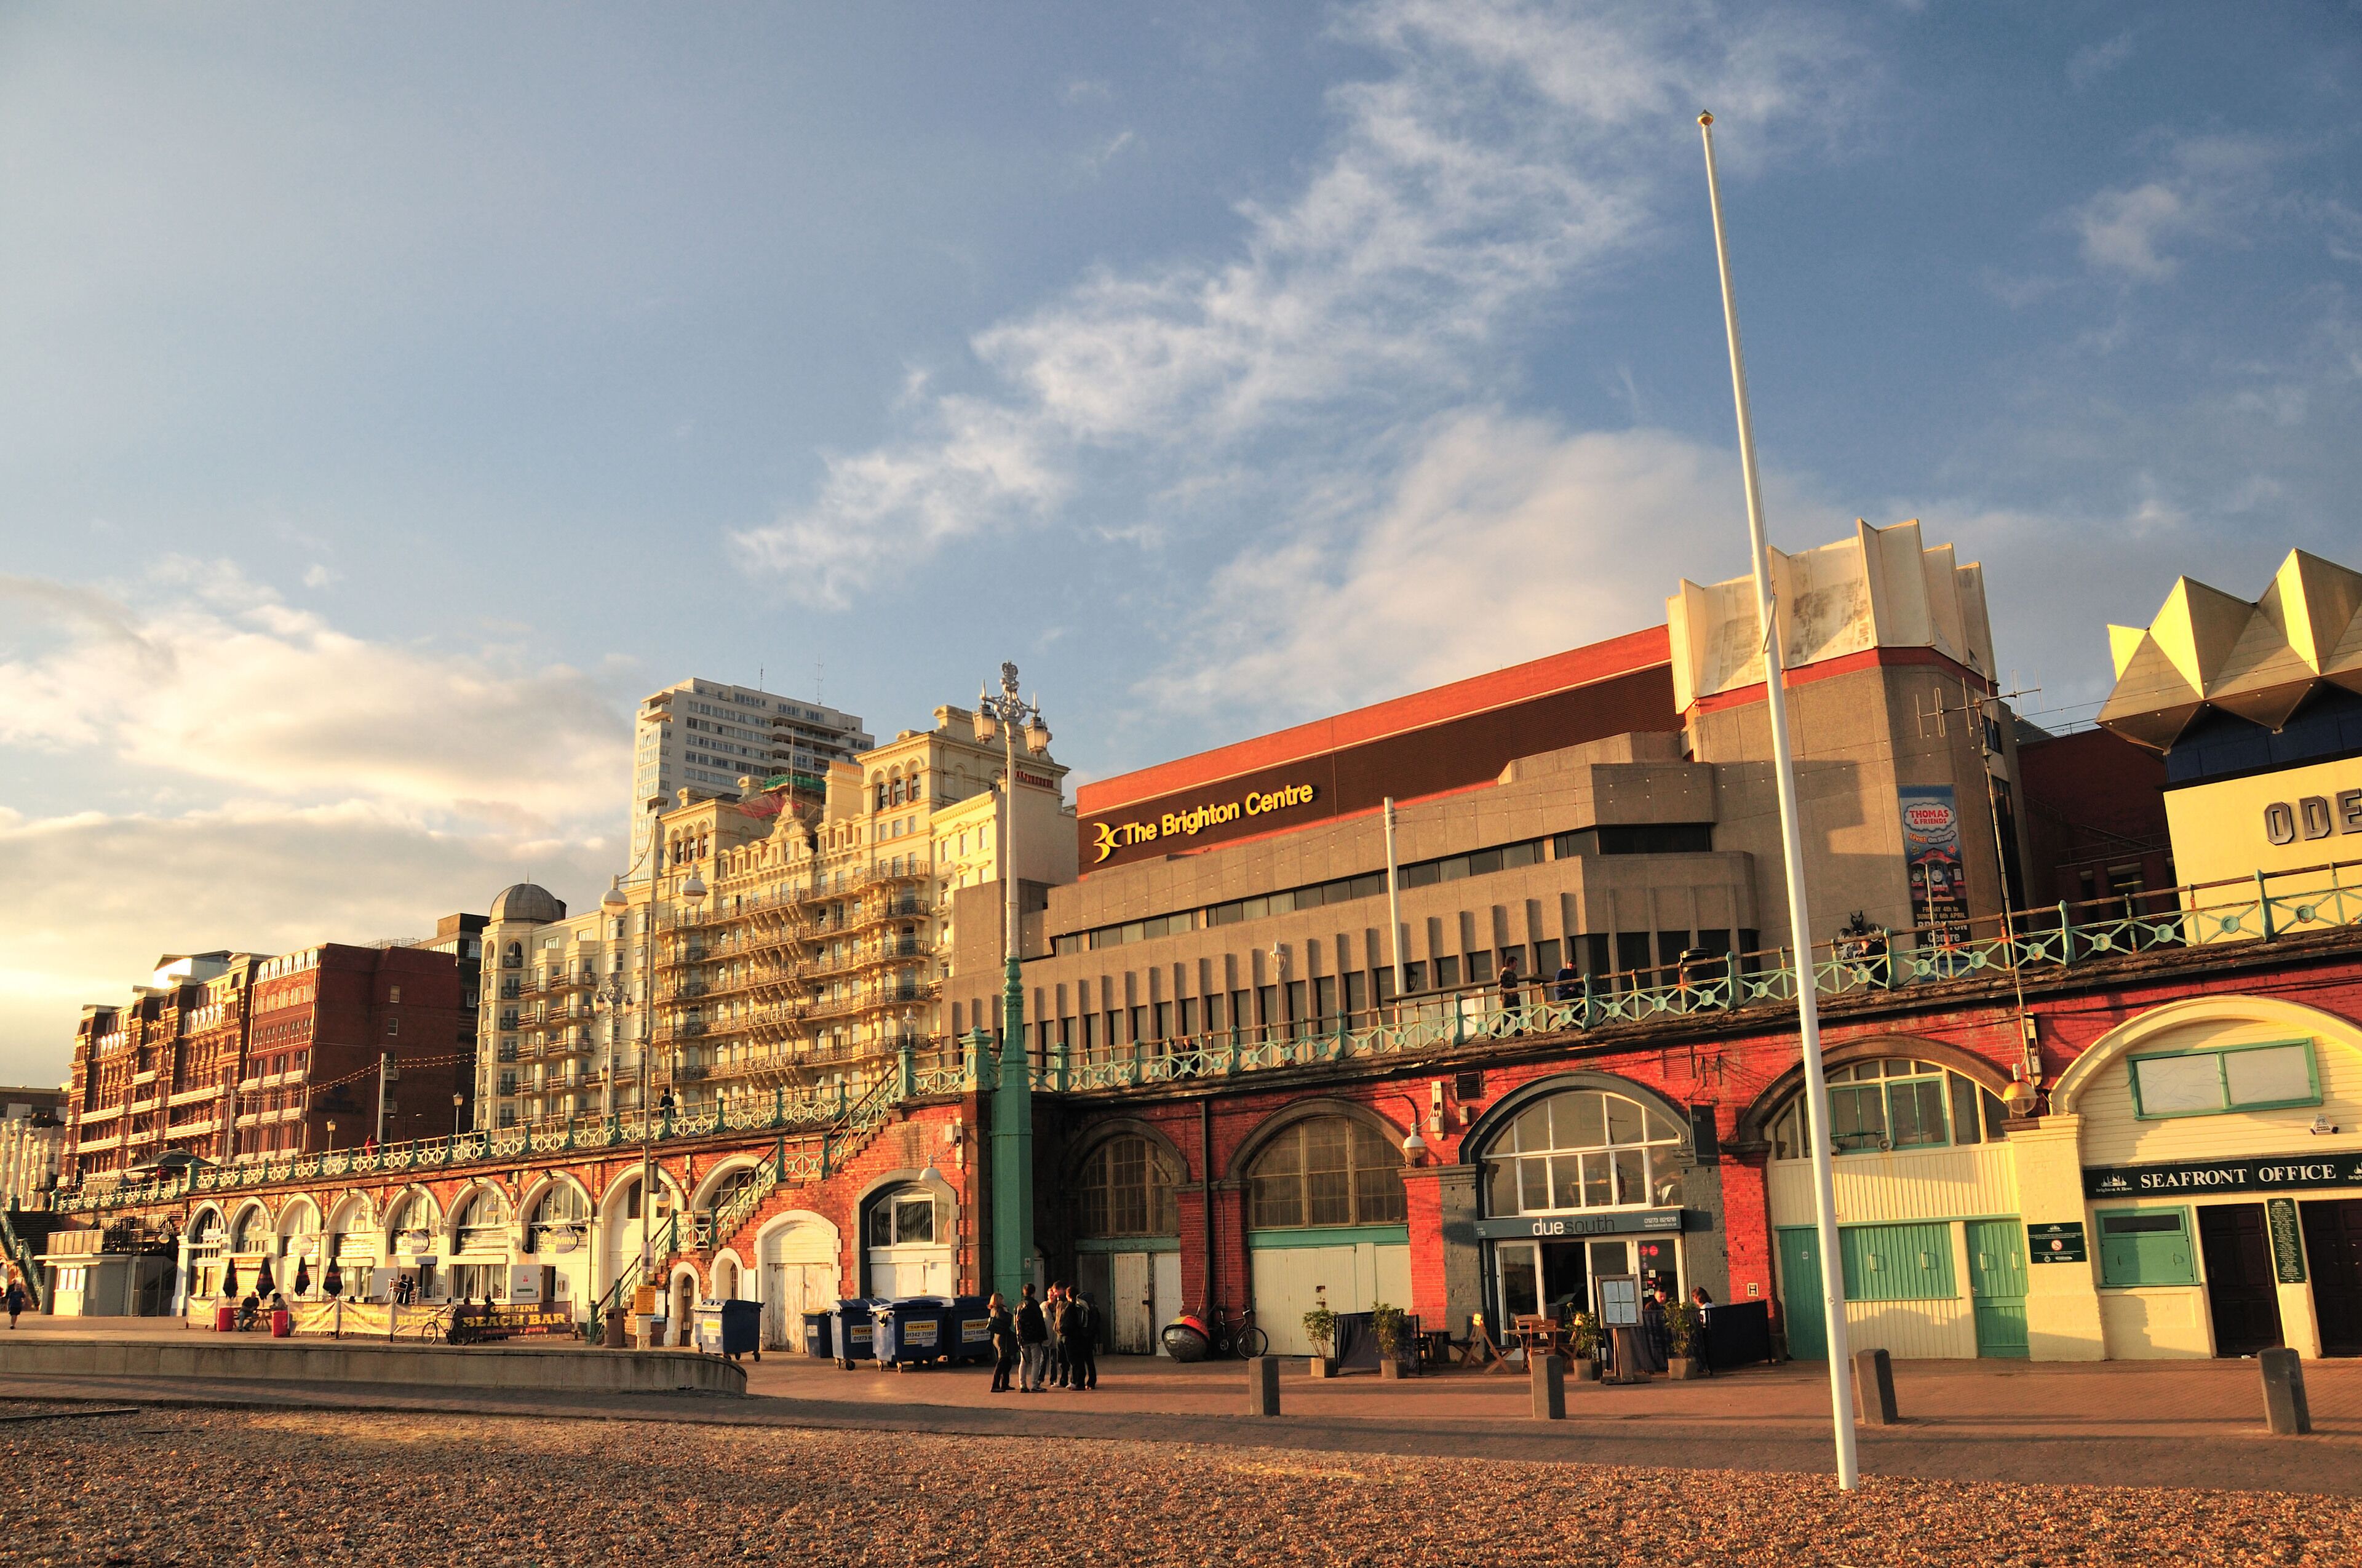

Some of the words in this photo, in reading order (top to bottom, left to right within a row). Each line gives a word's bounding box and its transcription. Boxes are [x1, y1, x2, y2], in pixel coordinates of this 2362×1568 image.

[1123, 821, 1158, 846] The
[1162, 803, 1240, 837] Brighton
[1245, 784, 1313, 816] Centre
[1909, 810, 1949, 818] THOMAS
[763, 1008, 790, 1024] VERE
[750, 1054, 787, 1071] GRAND
[2141, 1169, 2246, 1188] SEAFRONT
[2259, 1164, 2336, 1182] OFFICE
[544, 1236, 577, 1245] GEMINI
[1749, 1284, 1757, 1295] H
[490, 1303, 539, 1313] GEMINI
[463, 1316, 523, 1327] BEACH
[528, 1313, 565, 1325] BAR
